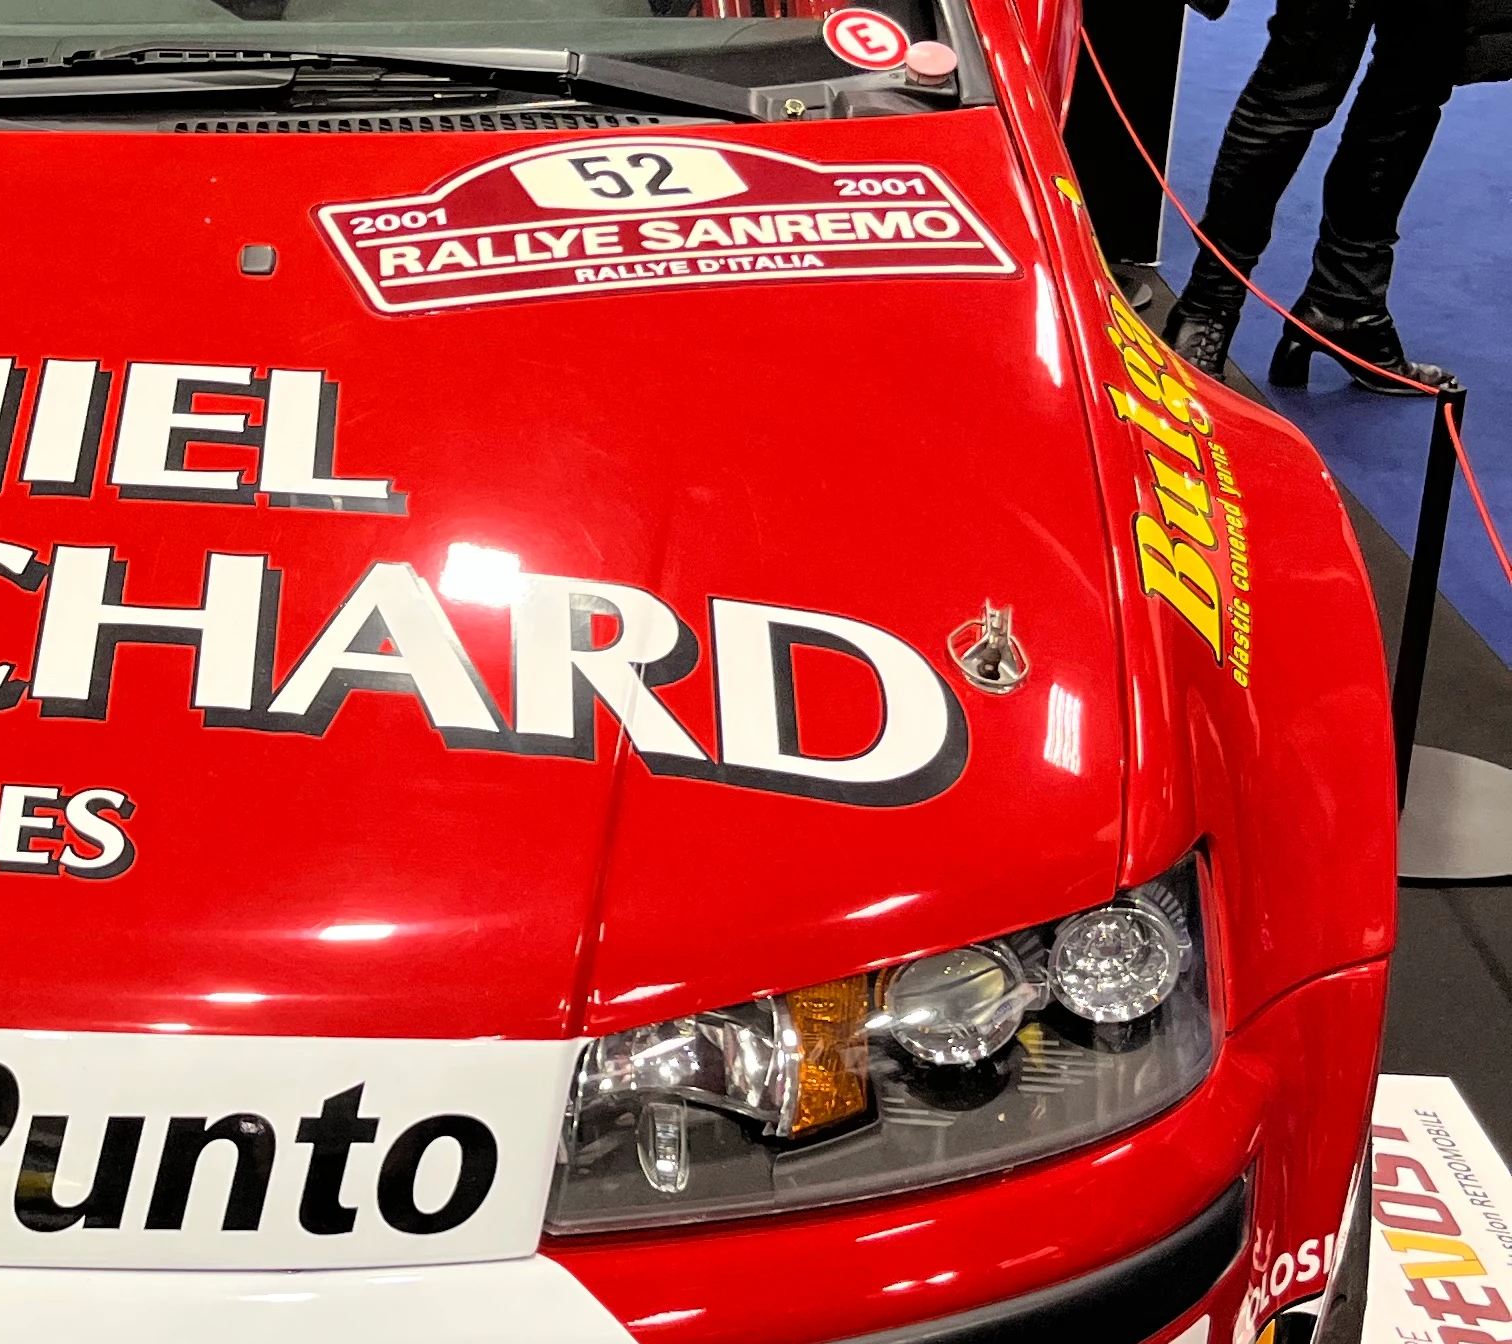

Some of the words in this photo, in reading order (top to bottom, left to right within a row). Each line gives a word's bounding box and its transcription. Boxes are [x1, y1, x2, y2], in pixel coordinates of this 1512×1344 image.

[845, 22, 889, 56] E
[570, 152, 692, 199] 52
[834, 177, 927, 197] 2001
[349, 209, 448, 235] 2001
[378, 225, 624, 278] RALLYE
[637, 209, 961, 251] SANREMO
[575, 260, 690, 284] RALLYE
[697, 253, 824, 274] D'ITALIA
[1224, 497, 1251, 593] covered
[1227, 597, 1251, 689] elastic
[1414, 1109, 1495, 1208] RETROMOBILE
